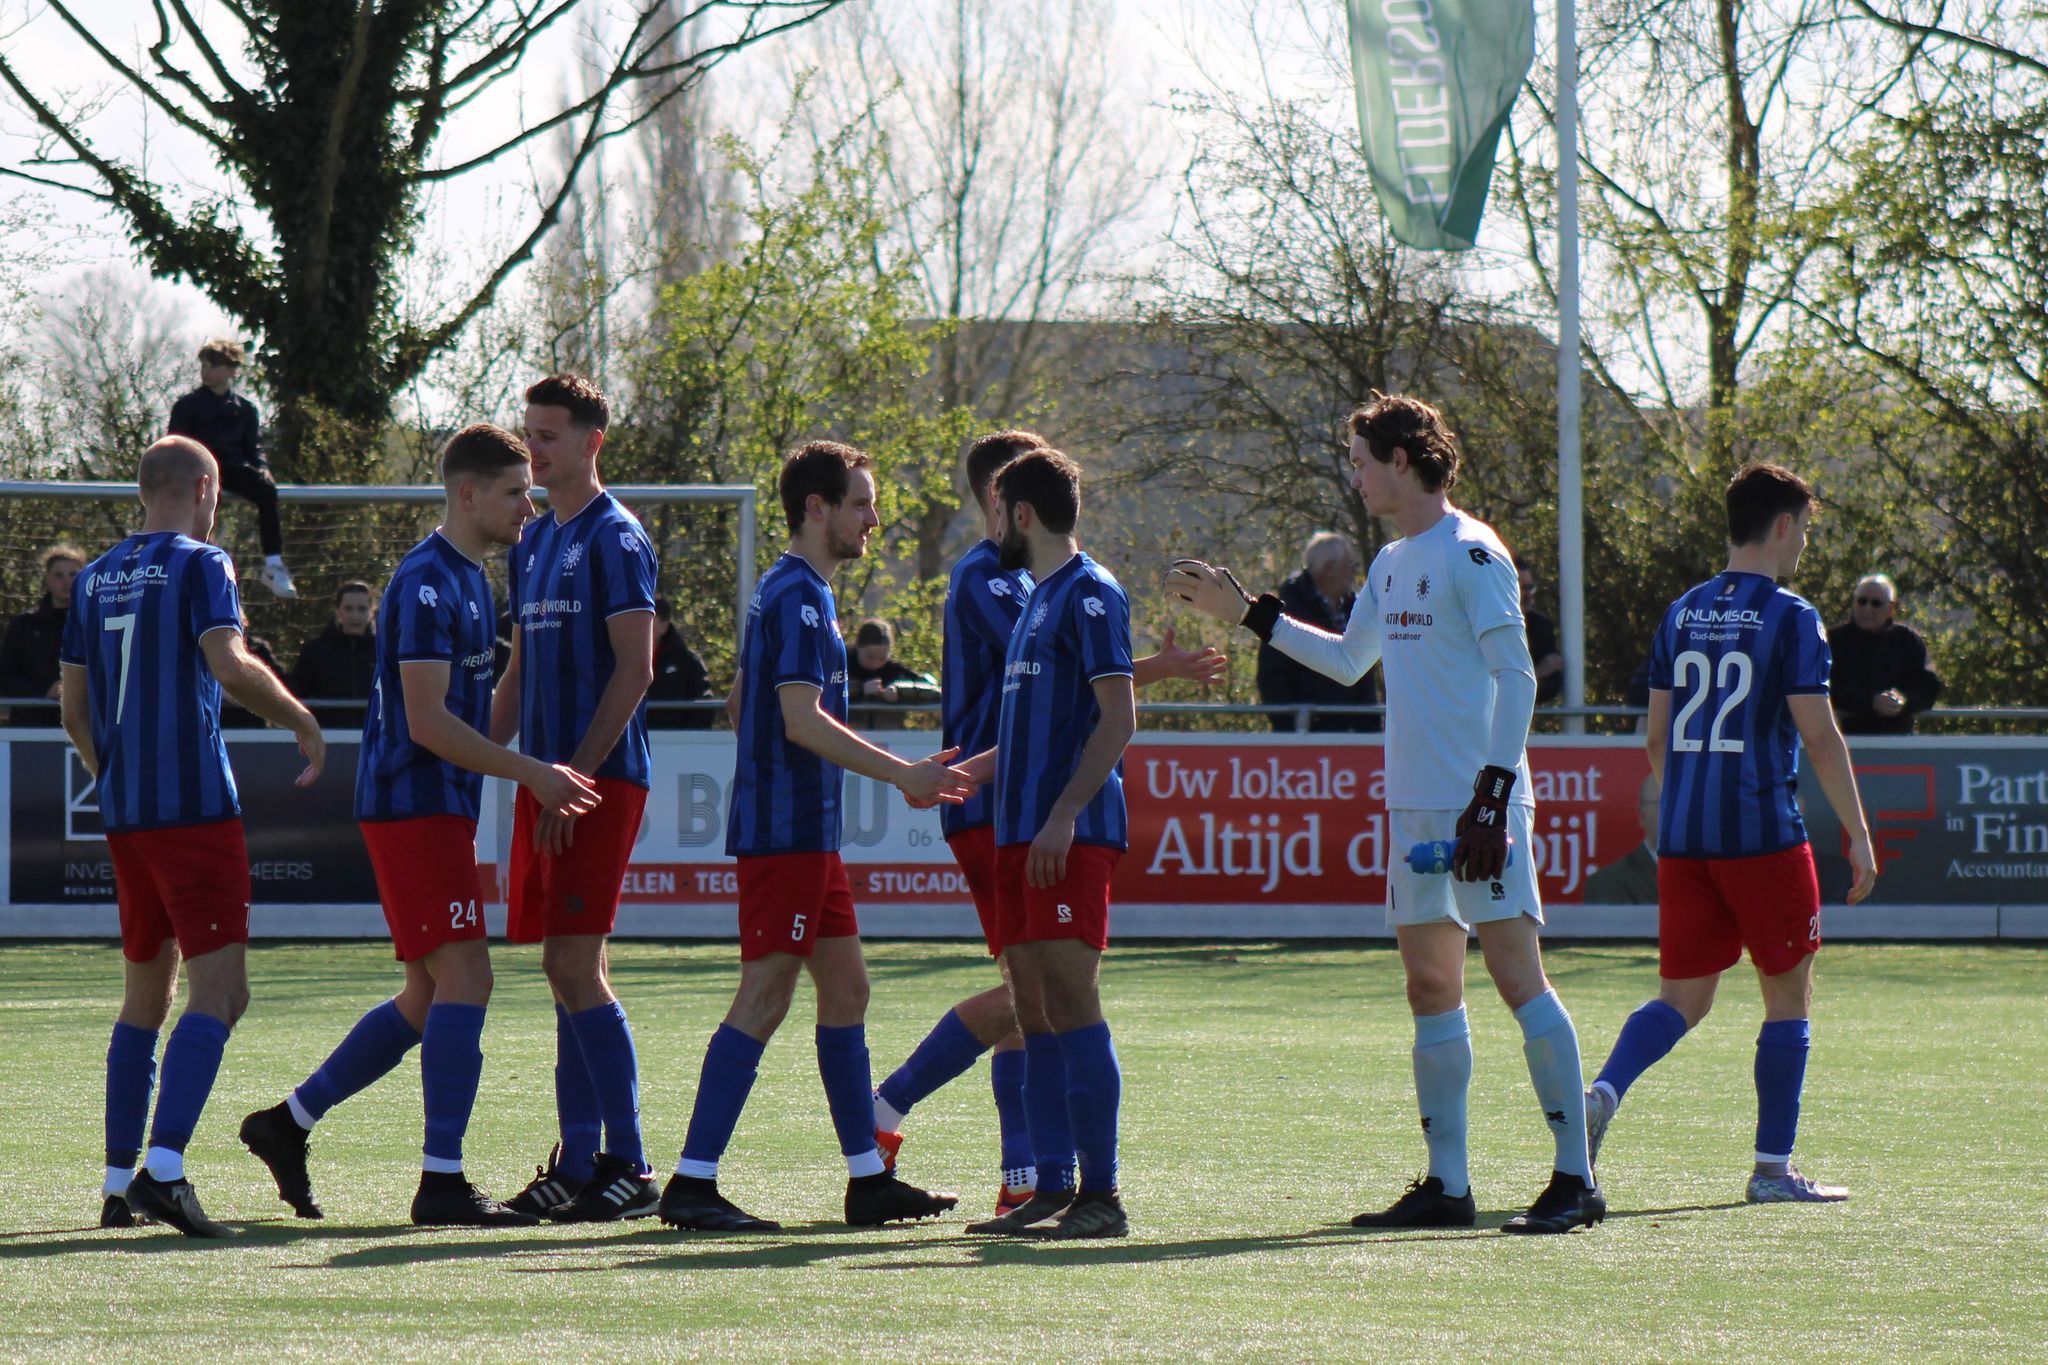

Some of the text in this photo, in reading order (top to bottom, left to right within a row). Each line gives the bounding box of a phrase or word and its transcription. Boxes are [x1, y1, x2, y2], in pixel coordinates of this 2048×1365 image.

[1685, 608, 1765, 625] NUMISOL
[104, 613, 136, 725] 7
[1672, 650, 1752, 752] 22
[1146, 760, 1218, 799] Uw
[1229, 756, 1357, 800] lokale
[1957, 765, 2048, 805] Part
[908, 829, 932, 847] 06
[1146, 812, 1324, 893] Altijd
[1945, 813, 2048, 854] in Fin
[450, 899, 477, 929] 24
[791, 913, 807, 941] 5
